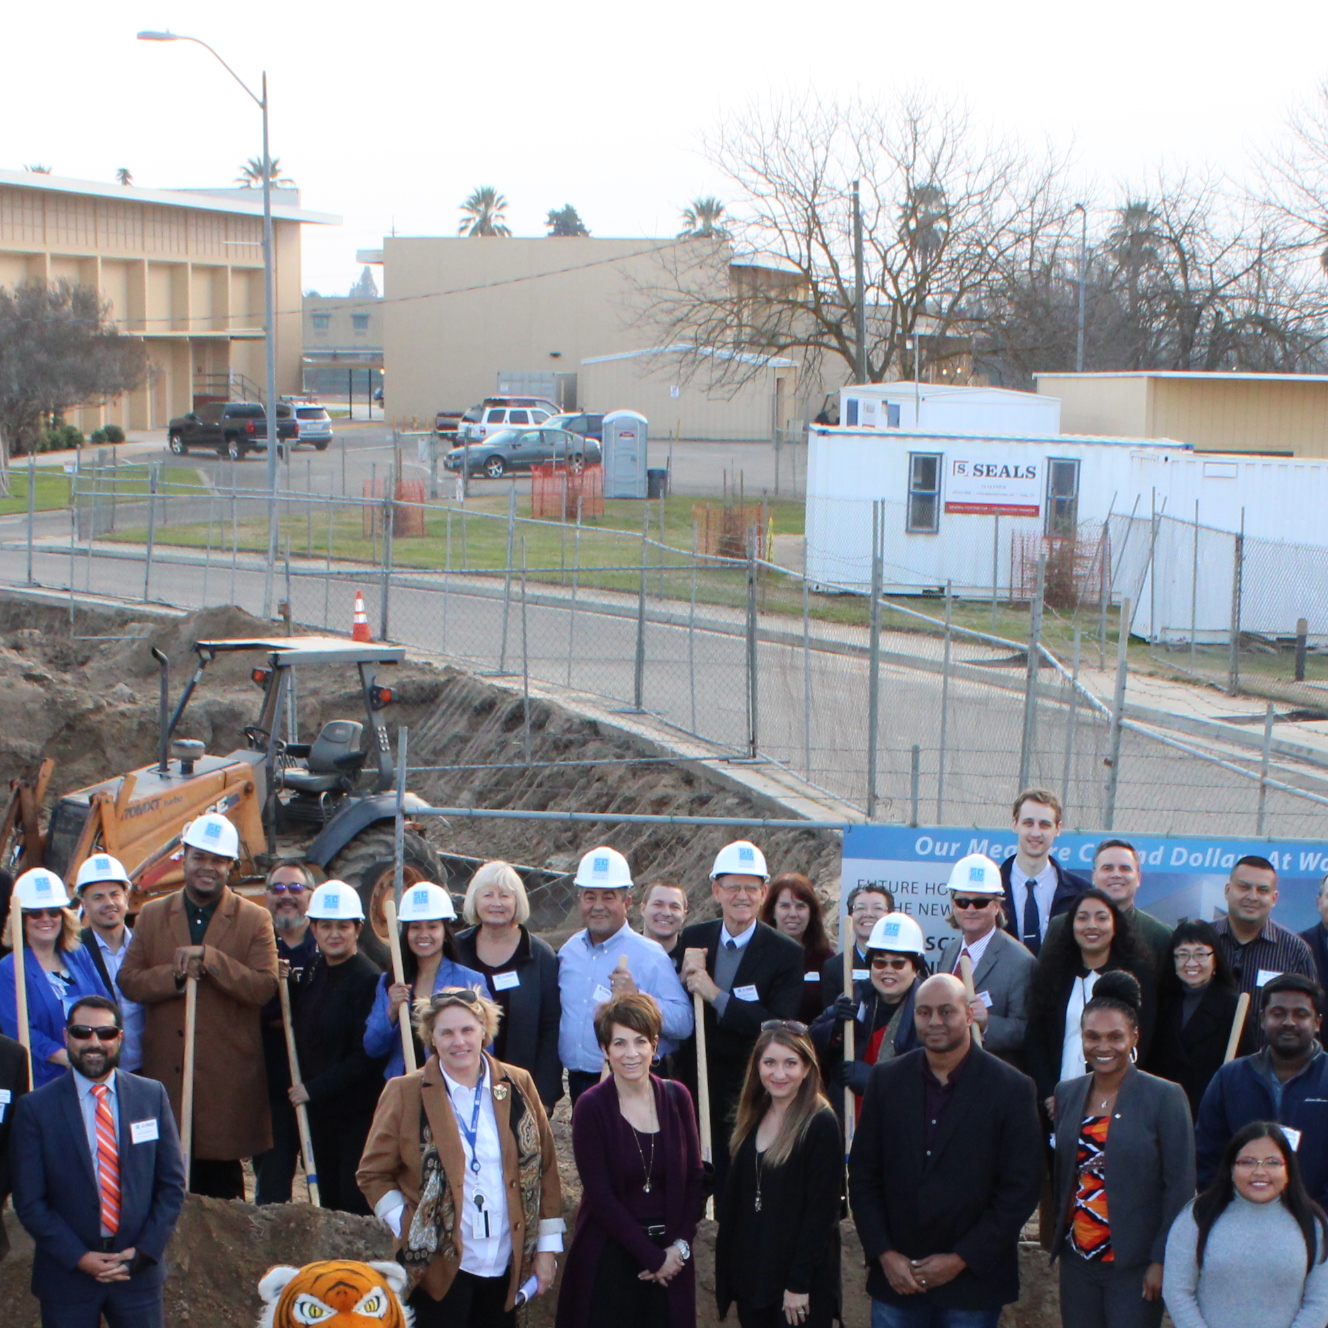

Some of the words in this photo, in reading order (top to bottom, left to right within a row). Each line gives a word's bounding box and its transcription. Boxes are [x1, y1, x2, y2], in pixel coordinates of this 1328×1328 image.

[973, 463, 1037, 480] SEALS
[914, 836, 957, 857] Our
[966, 839, 1071, 861] Meare
[1171, 847, 1250, 869] Dollar
[1269, 850, 1292, 871] At
